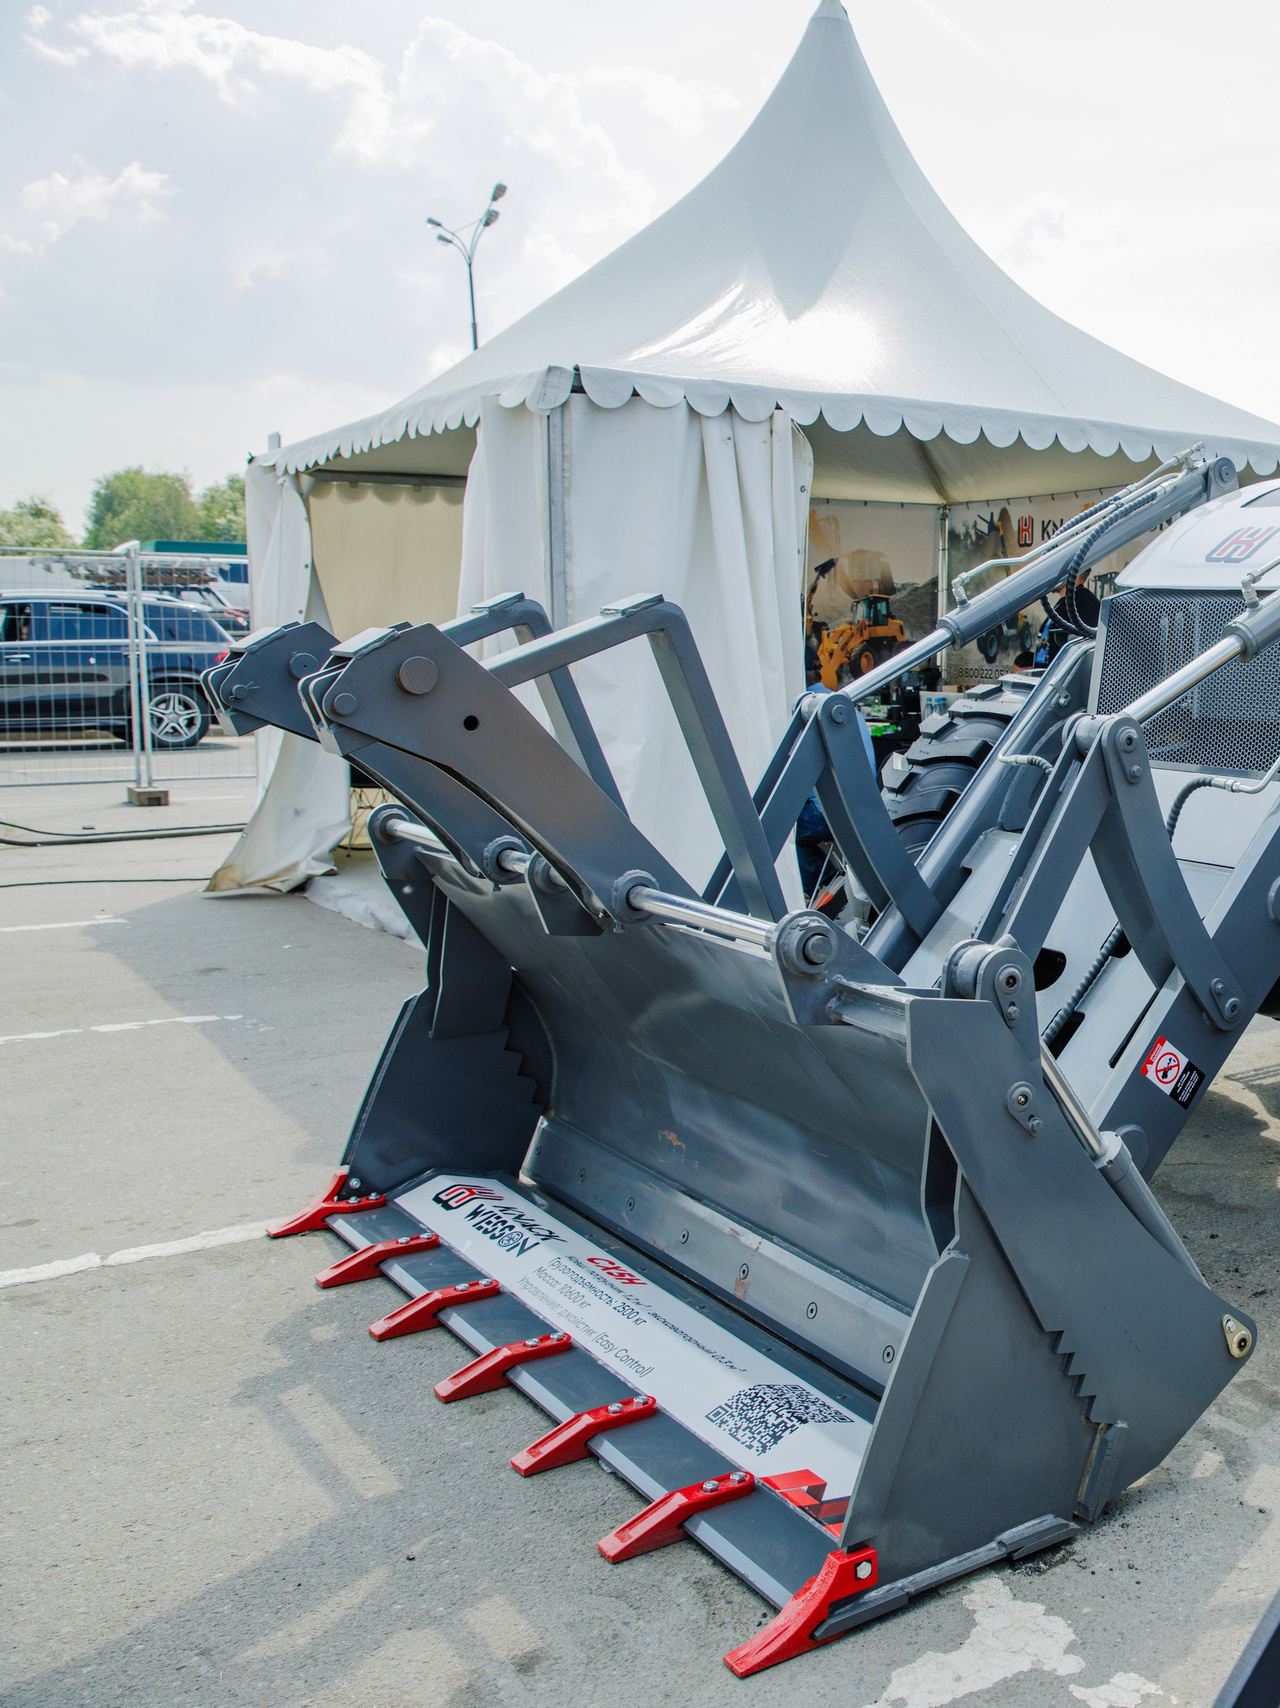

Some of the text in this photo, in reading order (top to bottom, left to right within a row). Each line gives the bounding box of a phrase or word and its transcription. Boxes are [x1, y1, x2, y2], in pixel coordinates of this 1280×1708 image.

[980, 668, 993, 679] 222
[464, 1203, 540, 1257] WESSON
[492, 1204, 568, 1243] KNACK
[532, 1265, 592, 1310] Масса: 10600 кг
[548, 1256, 647, 1327] Грузоподъемность: 2500 кг
[516, 1275, 655, 1379] Управление: джойстик (Easy Control)
